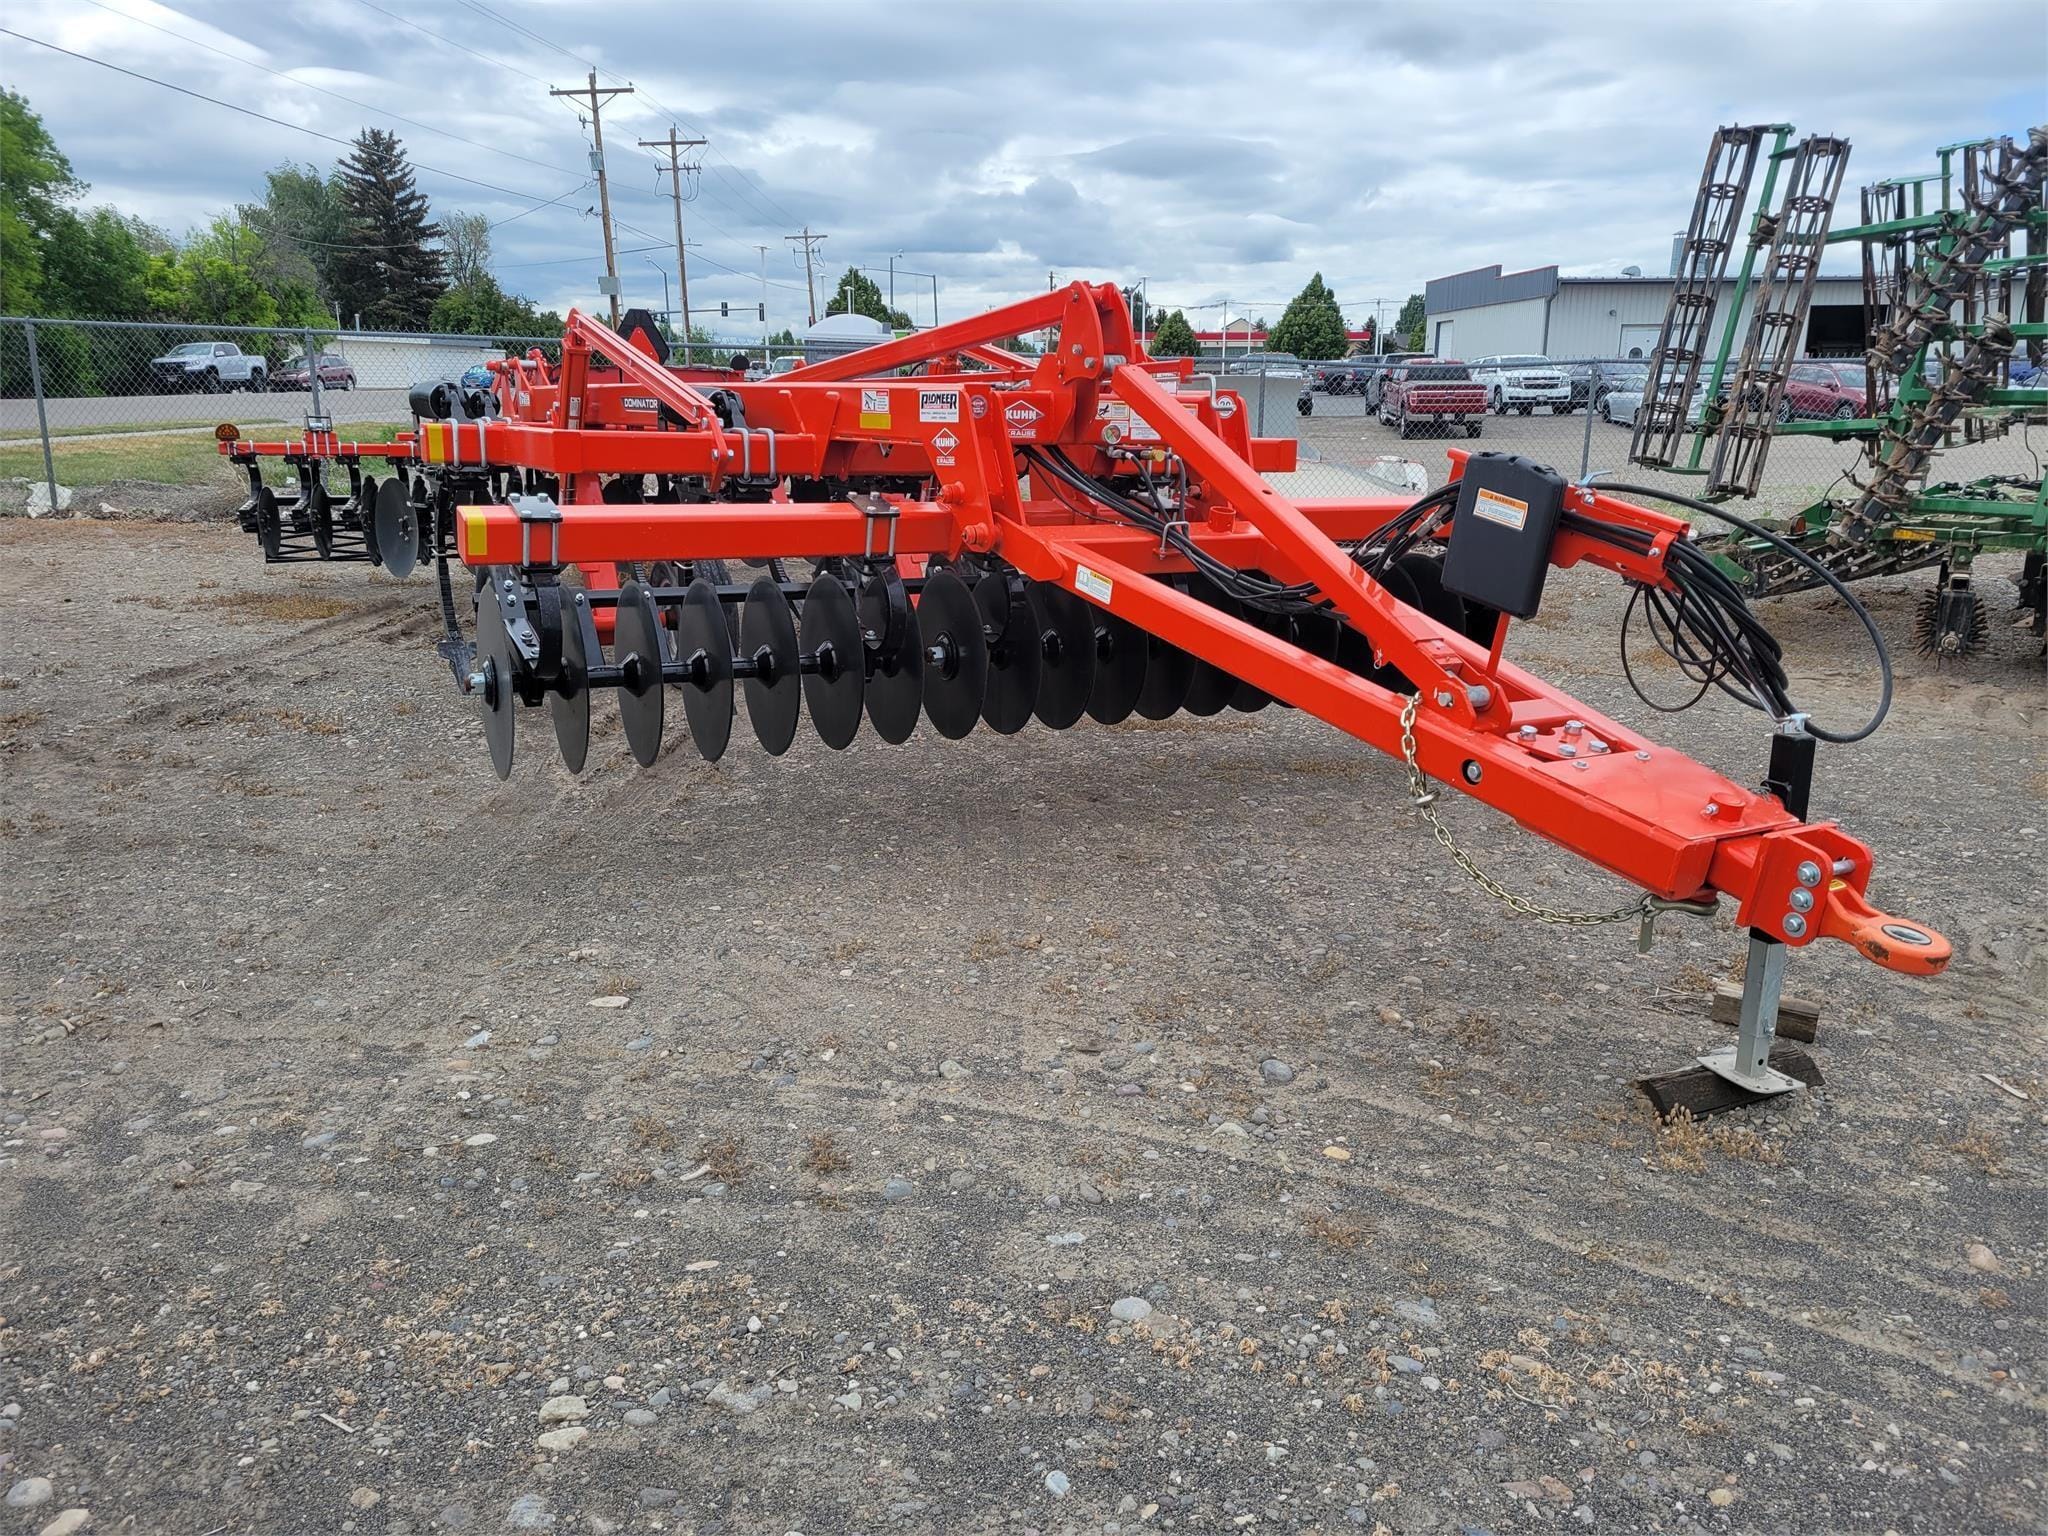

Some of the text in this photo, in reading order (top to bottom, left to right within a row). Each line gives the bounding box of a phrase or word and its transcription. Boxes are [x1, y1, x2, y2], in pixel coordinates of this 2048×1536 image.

[624, 398, 658, 408] DOMINATOR
[921, 393, 957, 409] PIONEER
[1006, 410, 1036, 420] KUHN
[935, 438, 955, 447] KUHN
